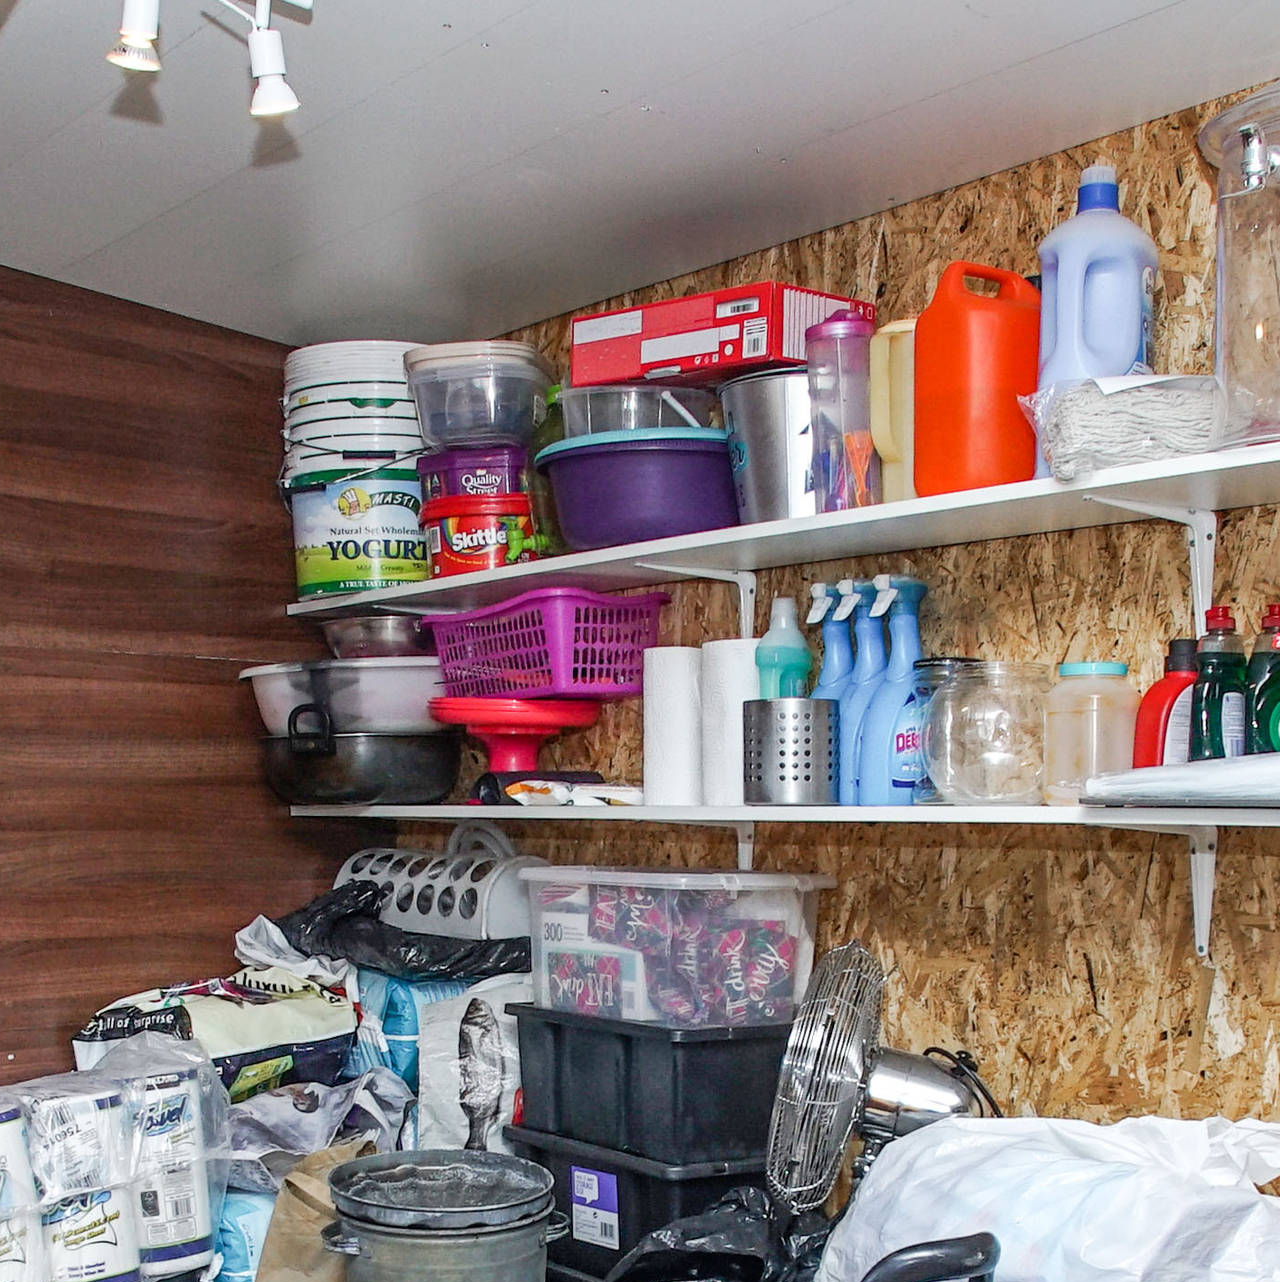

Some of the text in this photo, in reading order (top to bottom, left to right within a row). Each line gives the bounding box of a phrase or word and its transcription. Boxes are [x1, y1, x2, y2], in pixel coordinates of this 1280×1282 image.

[461, 472, 503, 488] Quality
[371, 493, 416, 508] MASTI
[330, 526, 362, 537] Natural
[451, 528, 508, 552] Skittle
[544, 922, 563, 942] 300
